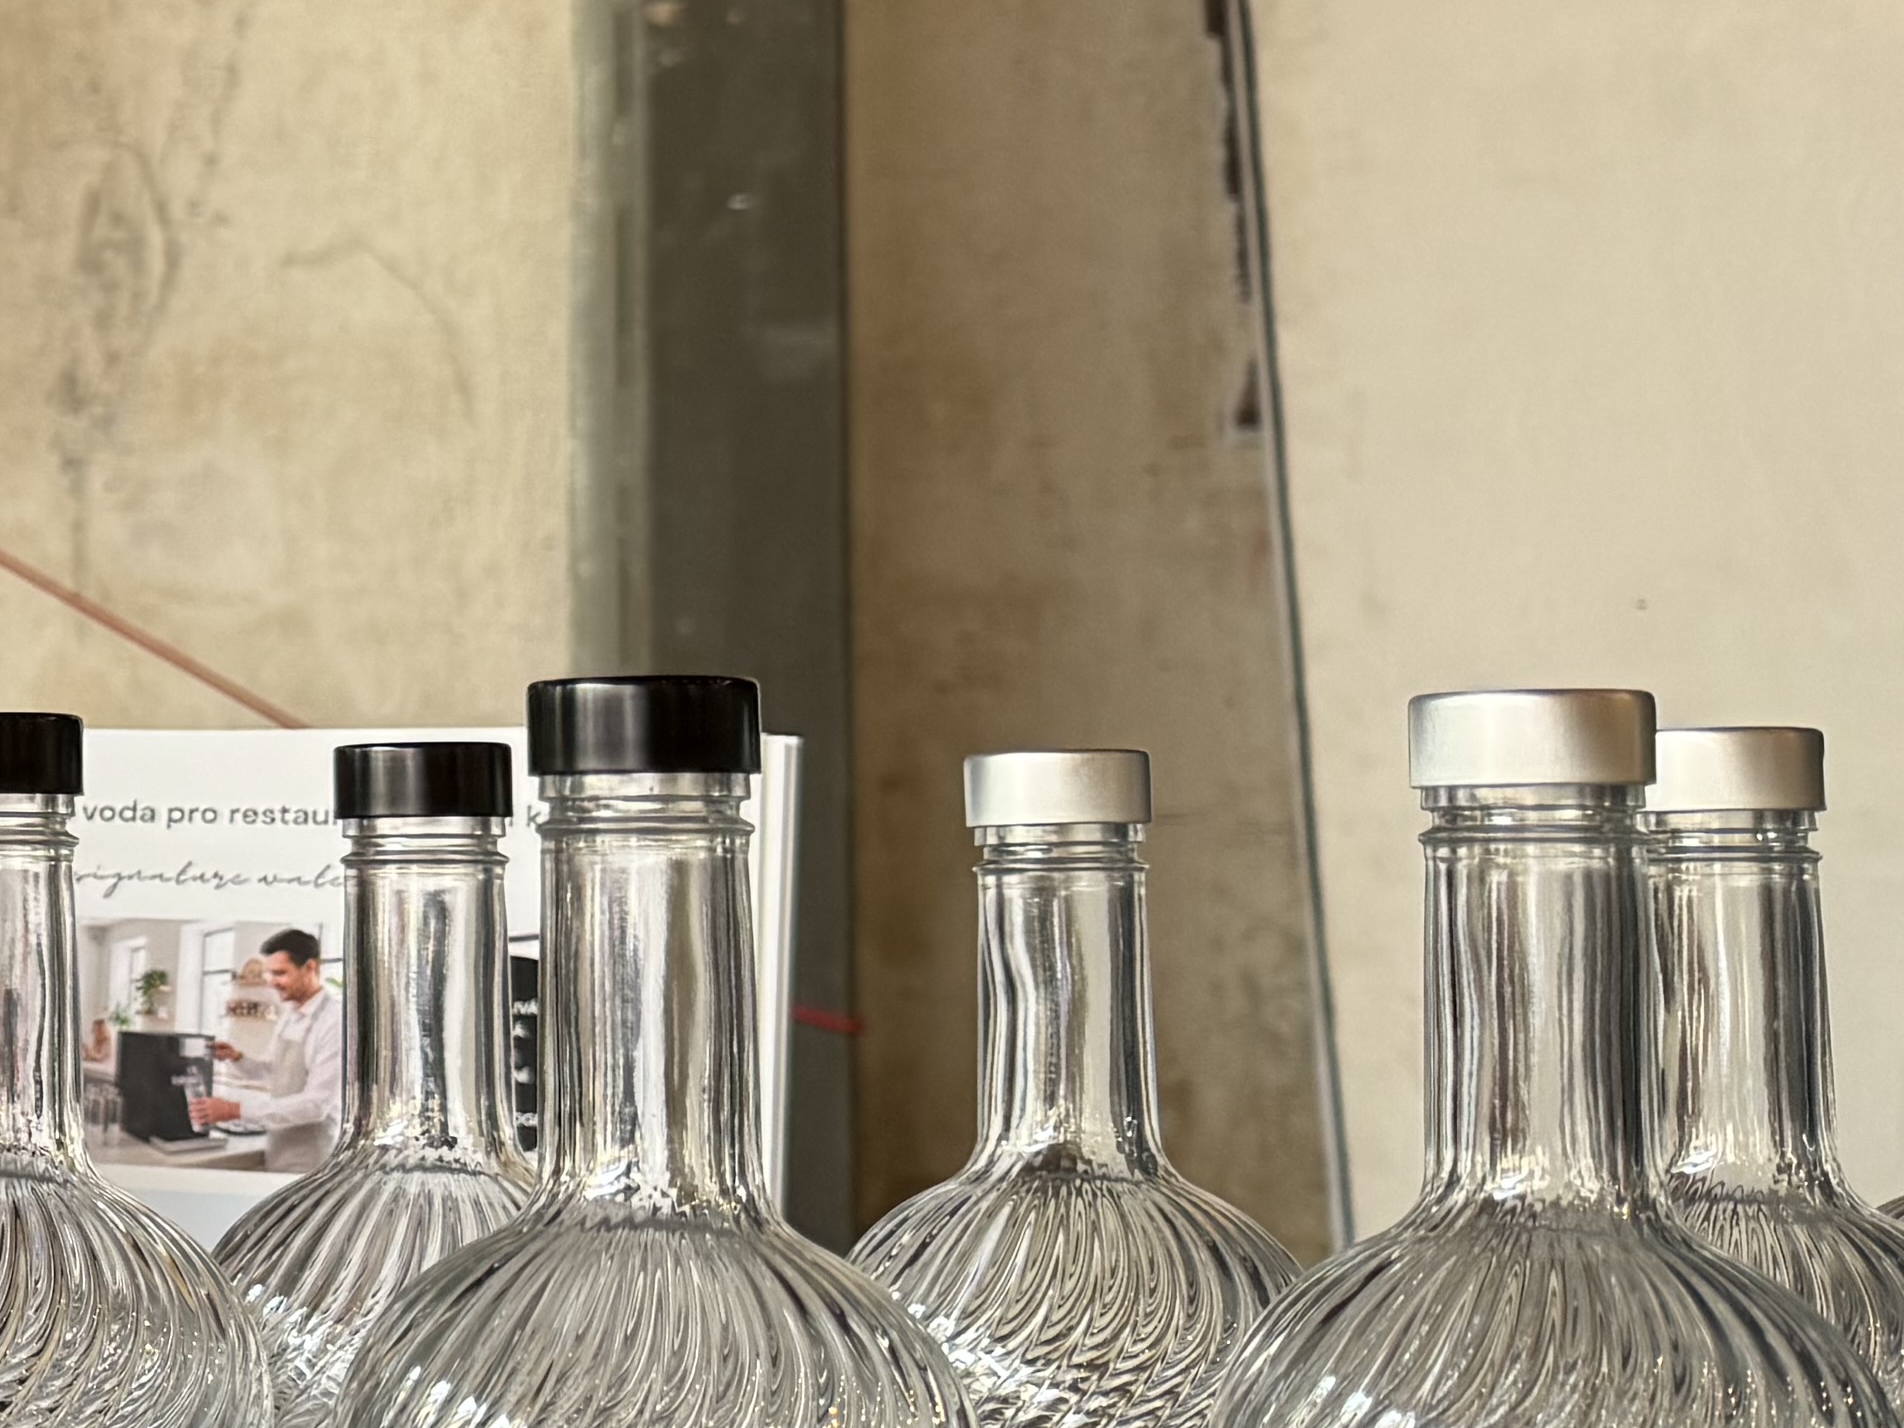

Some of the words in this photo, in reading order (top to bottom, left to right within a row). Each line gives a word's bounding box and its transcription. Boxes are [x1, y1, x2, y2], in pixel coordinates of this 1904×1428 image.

[82, 799, 156, 823] voda
[166, 807, 218, 830] pro
[229, 804, 338, 826] restau
